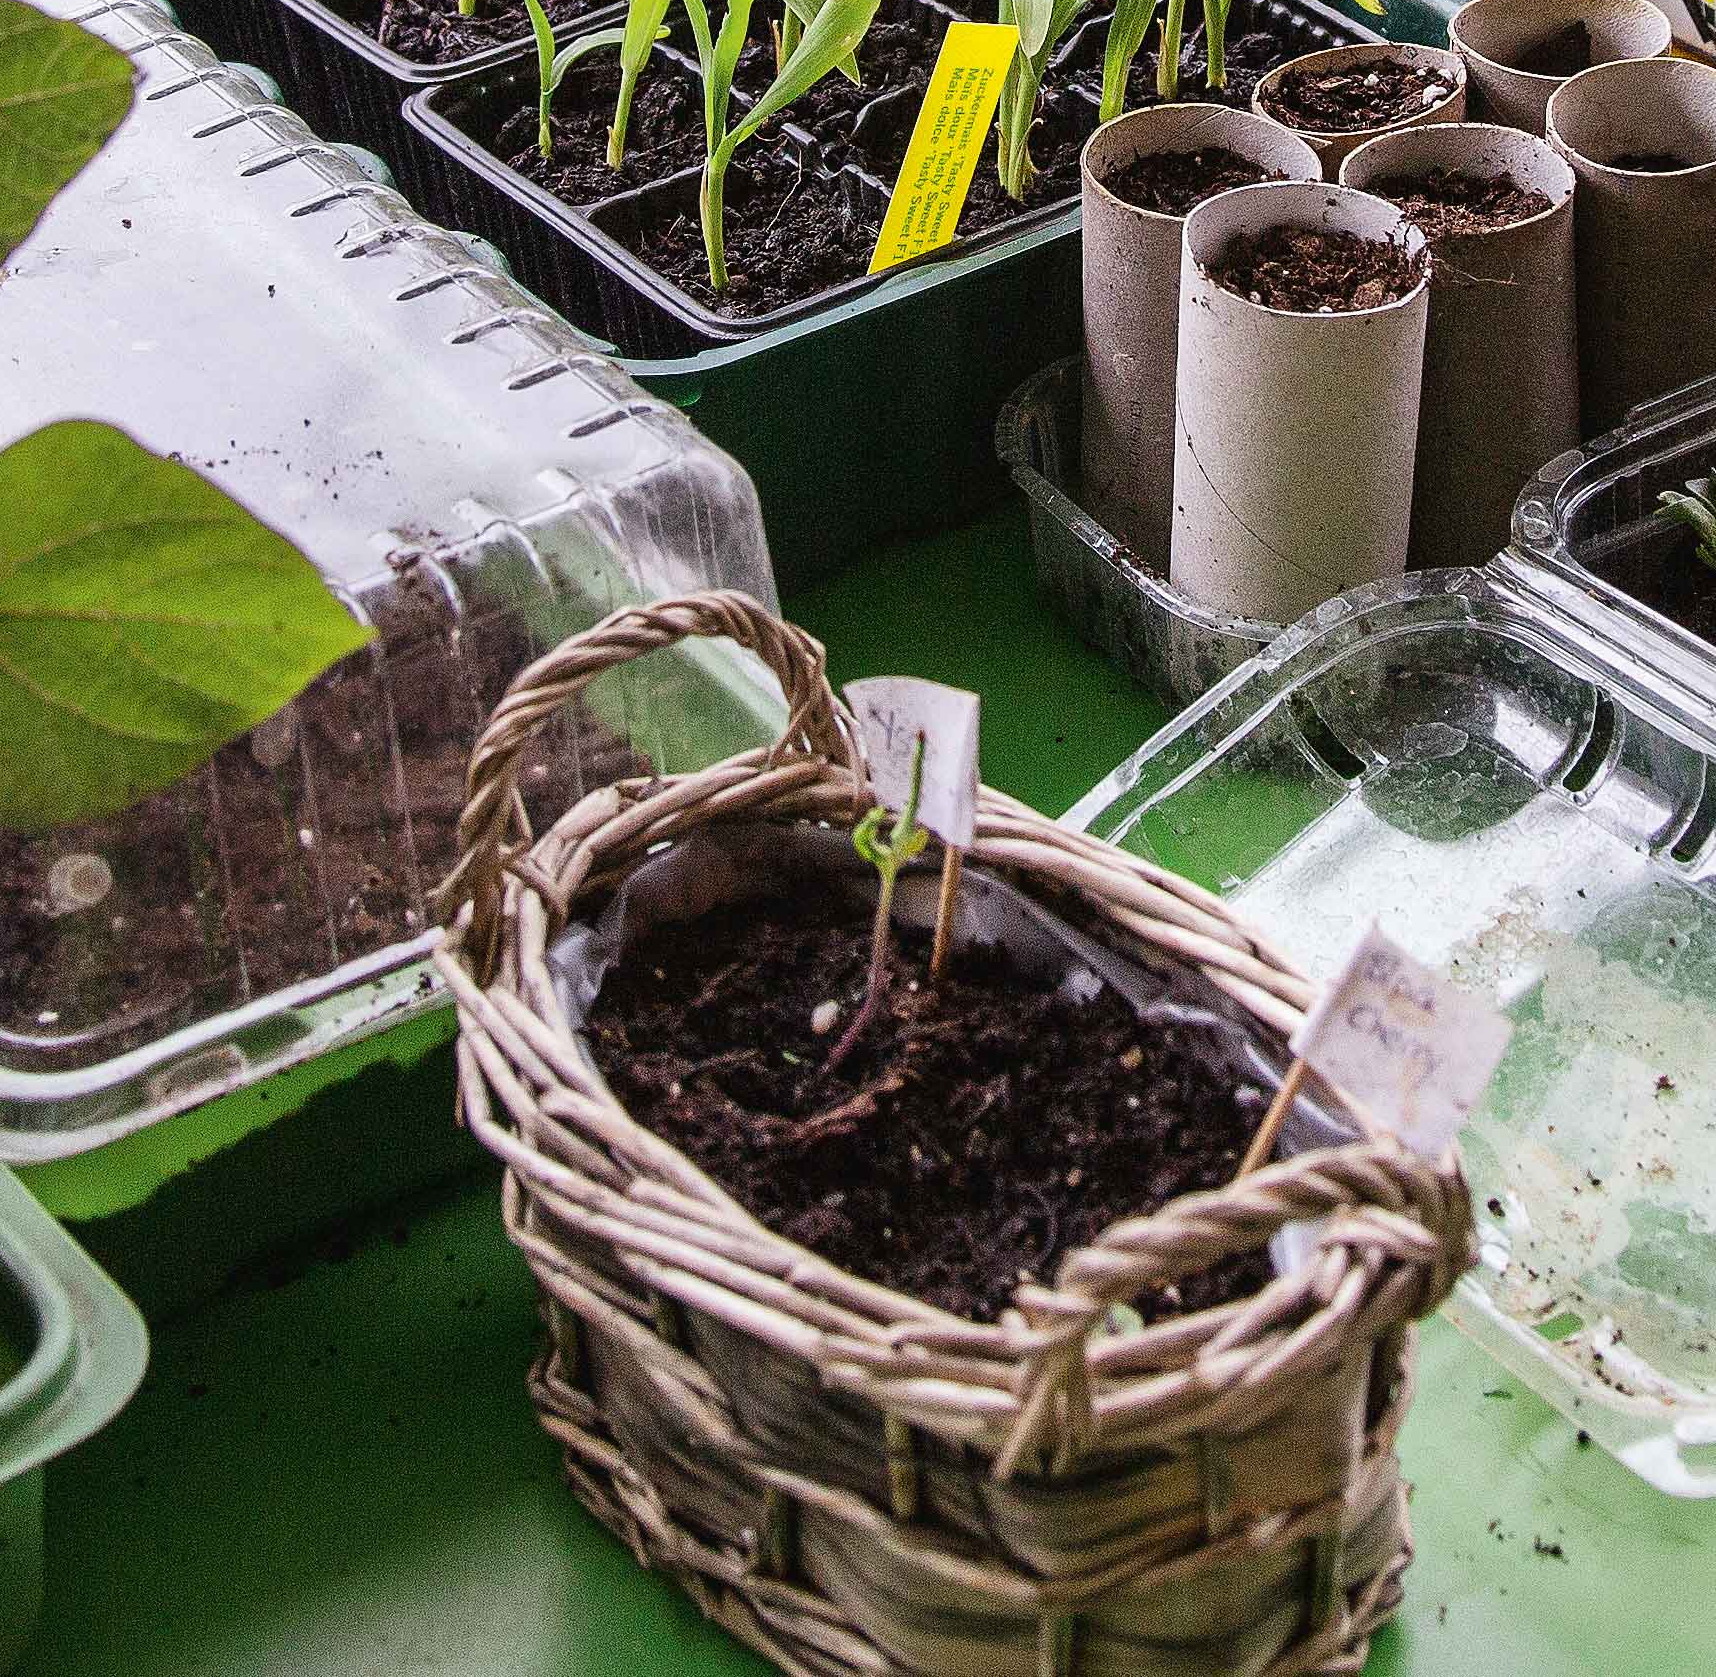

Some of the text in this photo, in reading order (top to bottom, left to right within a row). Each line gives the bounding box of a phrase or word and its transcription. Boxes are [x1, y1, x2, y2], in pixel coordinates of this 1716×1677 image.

[945, 68, 965, 101] Mais
[930, 106, 950, 144] dolce
[947, 106, 965, 140] doux
[960, 68, 995, 150] Zuckermais
[900, 195, 923, 239] Sweet
[916, 191, 939, 234] Sweet
[892, 244, 907, 261] F1
